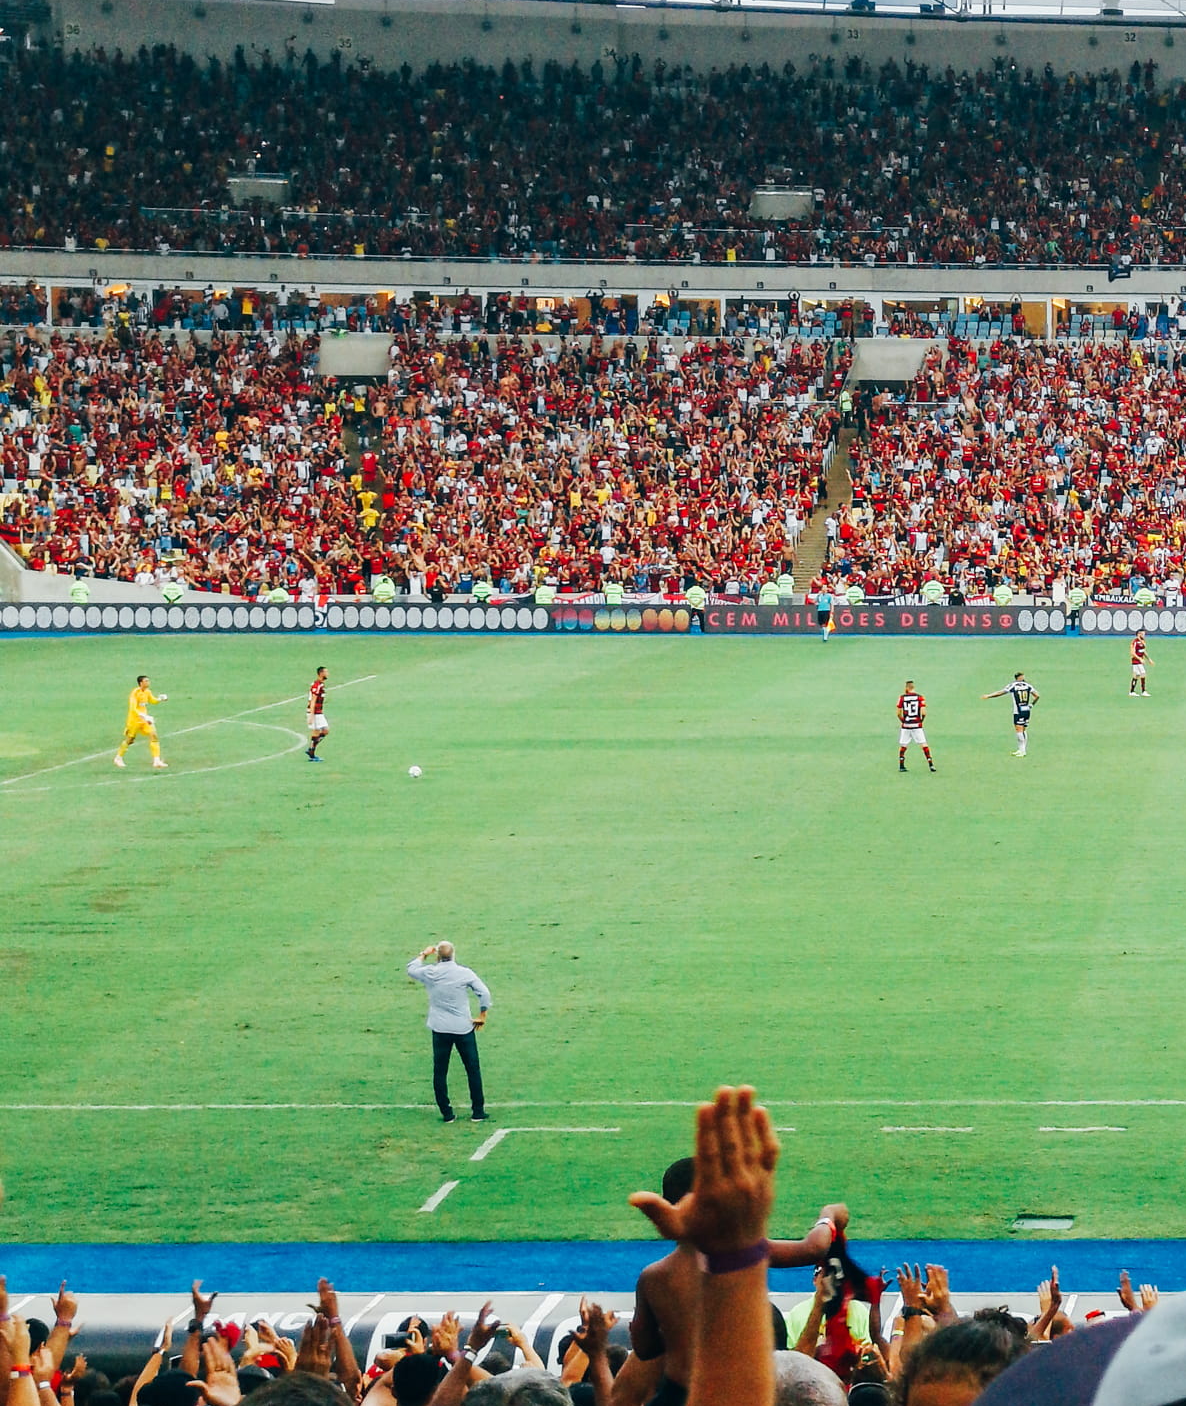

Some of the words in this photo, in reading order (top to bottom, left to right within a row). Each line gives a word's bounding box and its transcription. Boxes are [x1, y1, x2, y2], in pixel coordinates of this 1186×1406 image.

[1124, 32, 1136, 41] 32
[708, 612, 757, 627] CEM
[772, 609, 885, 627] MILÕES
[902, 612, 930, 627] DE
[946, 612, 992, 627] UNS
[1018, 690, 1028, 702] 10
[904, 701, 918, 715] 43
